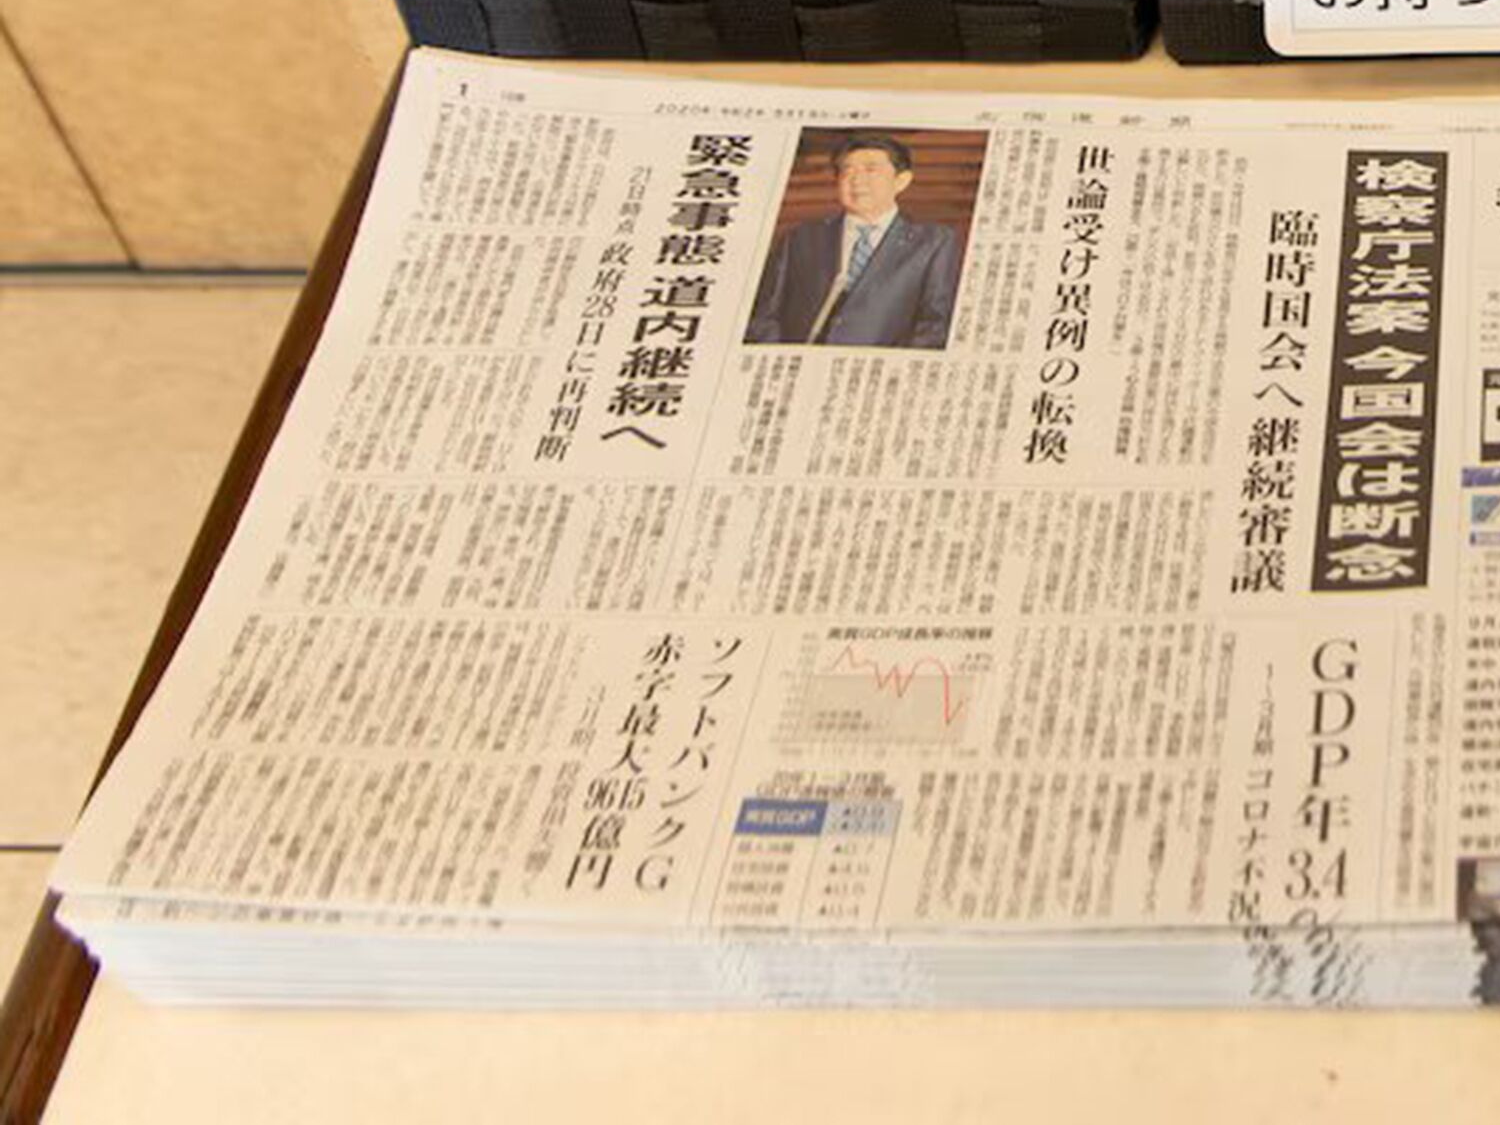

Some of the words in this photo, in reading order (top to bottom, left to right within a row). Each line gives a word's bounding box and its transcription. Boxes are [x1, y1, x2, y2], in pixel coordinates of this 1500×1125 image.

[656, 133, 753, 265] 緊急事態
[1023, 144, 1115, 465] 世論受け異例の転換
[1344, 158, 1439, 336] 検察庁法案
[534, 241, 634, 463] 政府28日に再判断
[600, 275, 711, 450] 道内継続へ
[1230, 209, 1320, 594] 臨時国会へ継続審議
[1326, 345, 1430, 583] 今国会は断念
[565, 633, 685, 891] 赤字最大9615億円
[634, 637, 743, 891] ソフトバンクG
